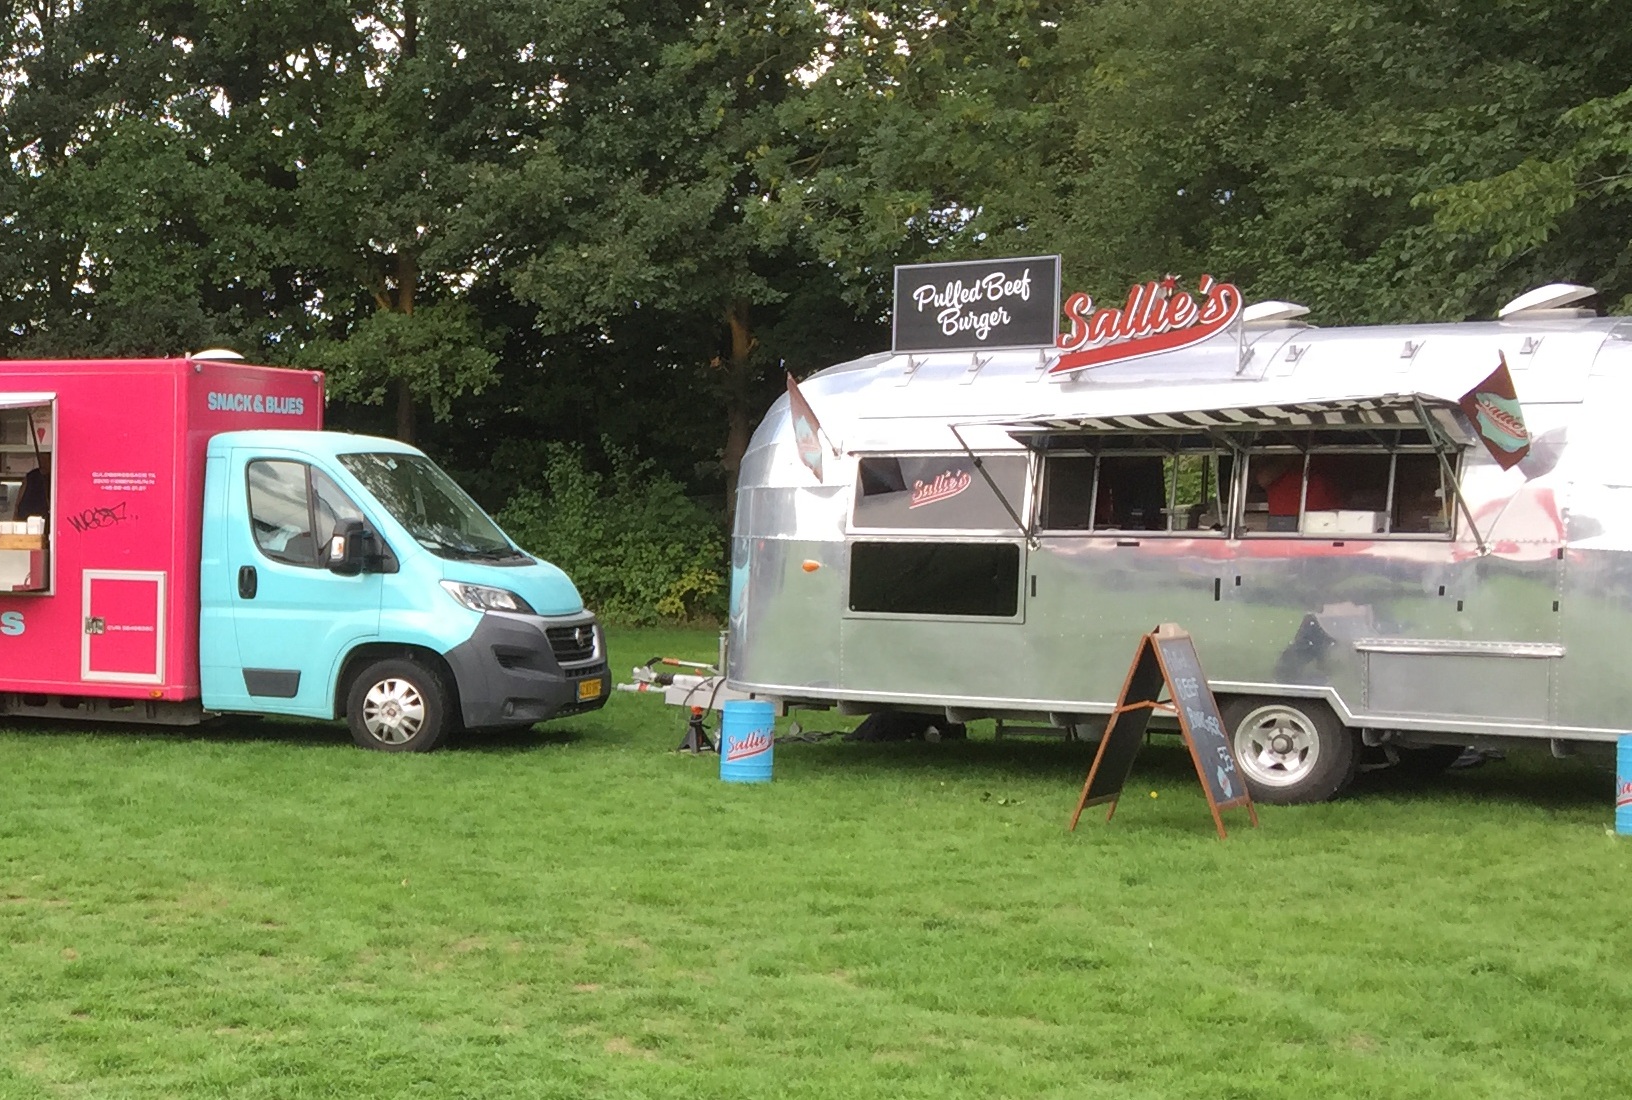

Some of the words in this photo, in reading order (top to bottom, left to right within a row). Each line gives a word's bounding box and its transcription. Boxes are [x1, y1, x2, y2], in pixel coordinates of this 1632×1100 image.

[913, 279, 983, 312] Pulled
[982, 268, 1032, 301] Beef
[937, 306, 1011, 340] Burger
[1056, 273, 1244, 352] Sallie's
[208, 392, 253, 412] SNACK
[253, 394, 265, 413] &
[265, 396, 304, 415] BLUES
[912, 469, 971, 501] Sallie's
